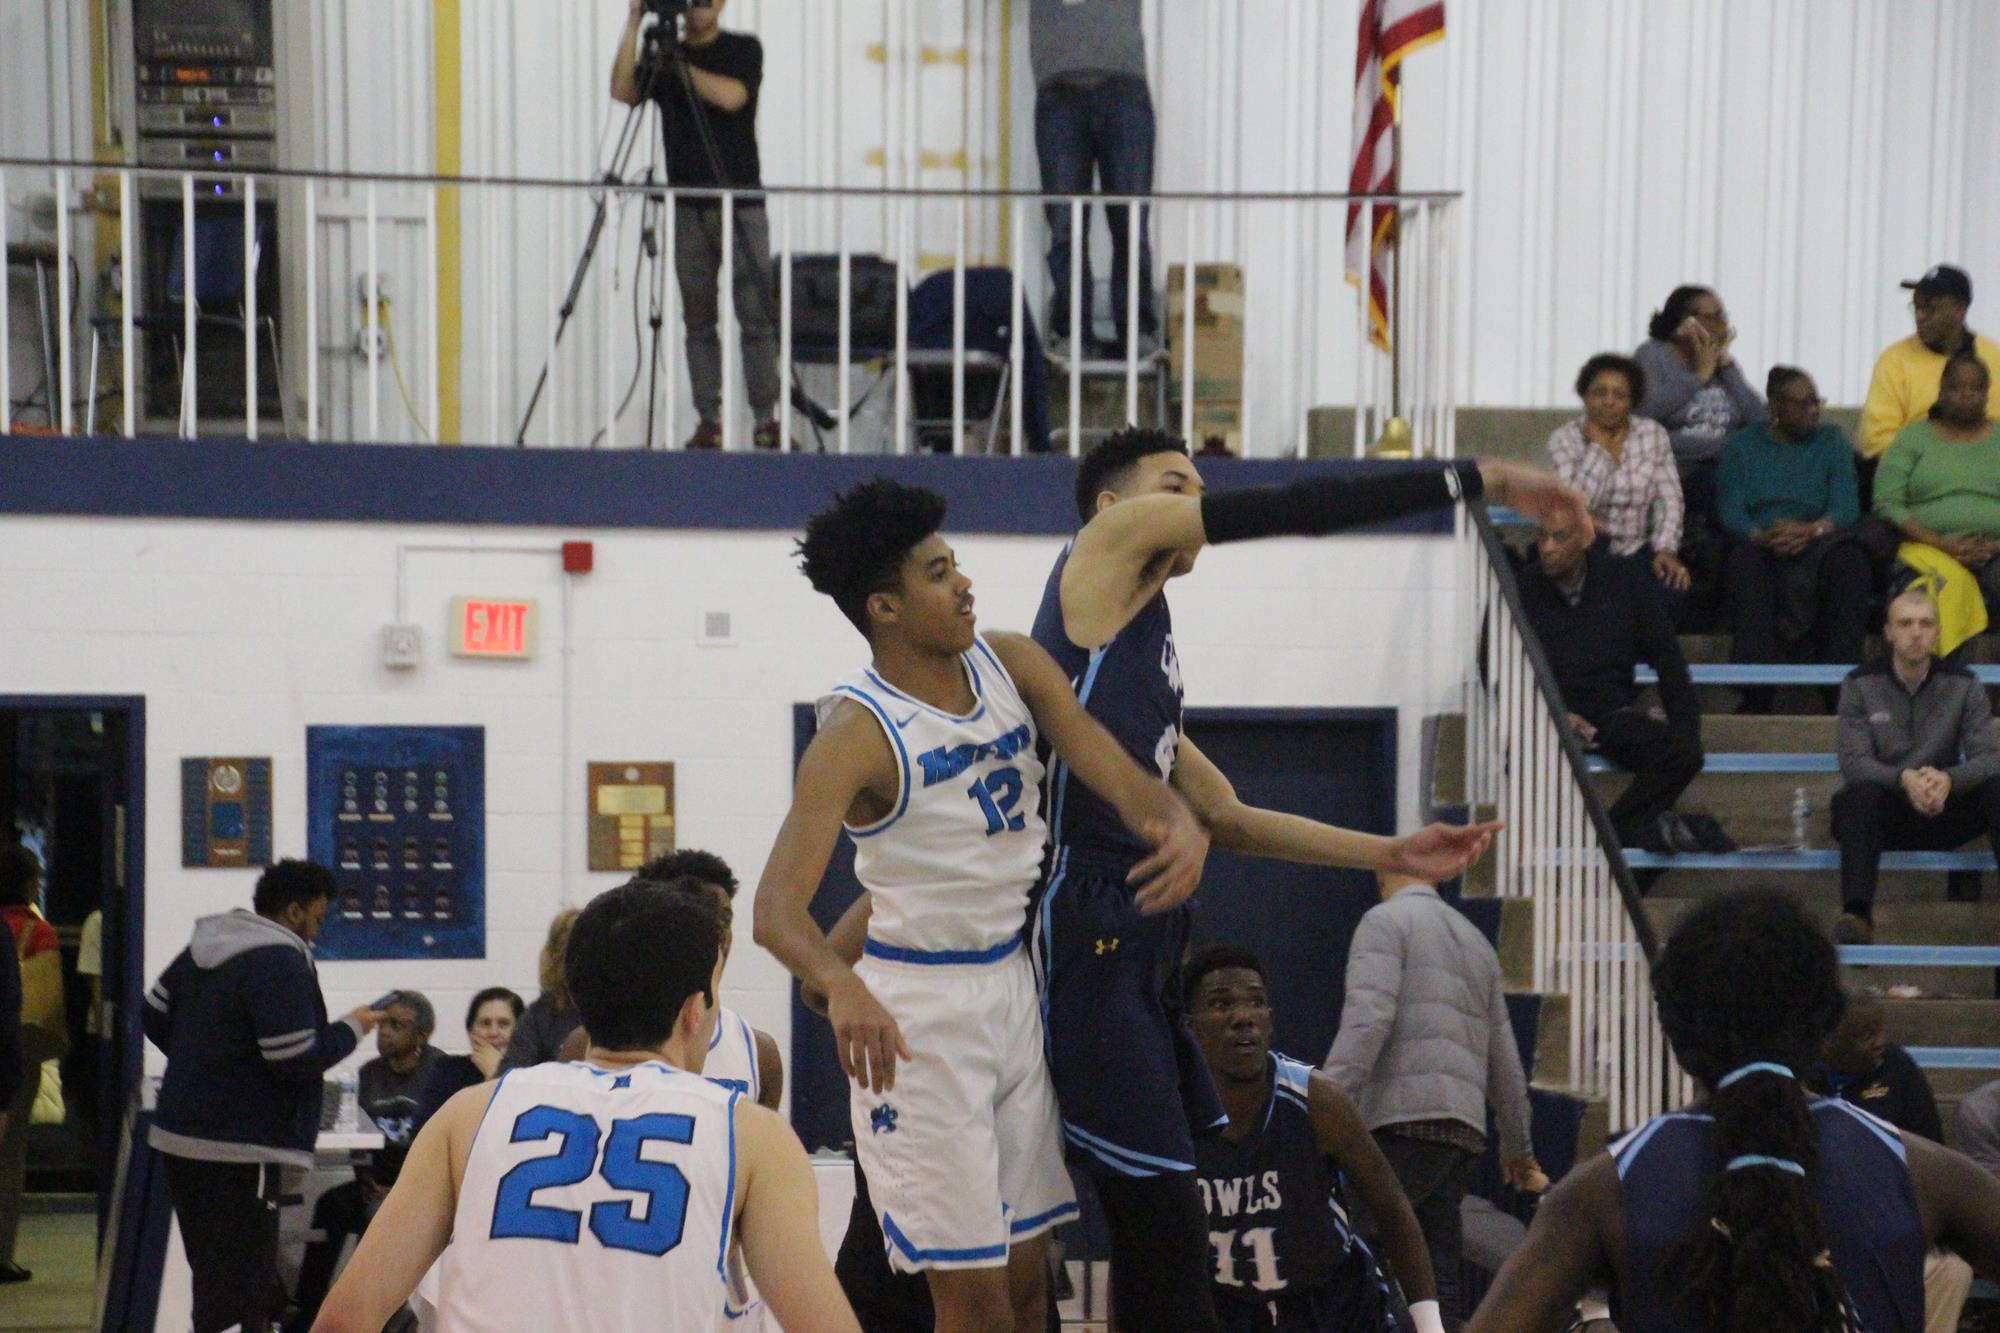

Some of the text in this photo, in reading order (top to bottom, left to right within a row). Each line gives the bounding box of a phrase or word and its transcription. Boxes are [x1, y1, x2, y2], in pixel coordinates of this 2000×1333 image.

[464, 601, 528, 652] EXIT
[967, 767, 1026, 837] 12
[489, 1104, 696, 1257] 25
[1208, 1227, 1288, 1291] 11
